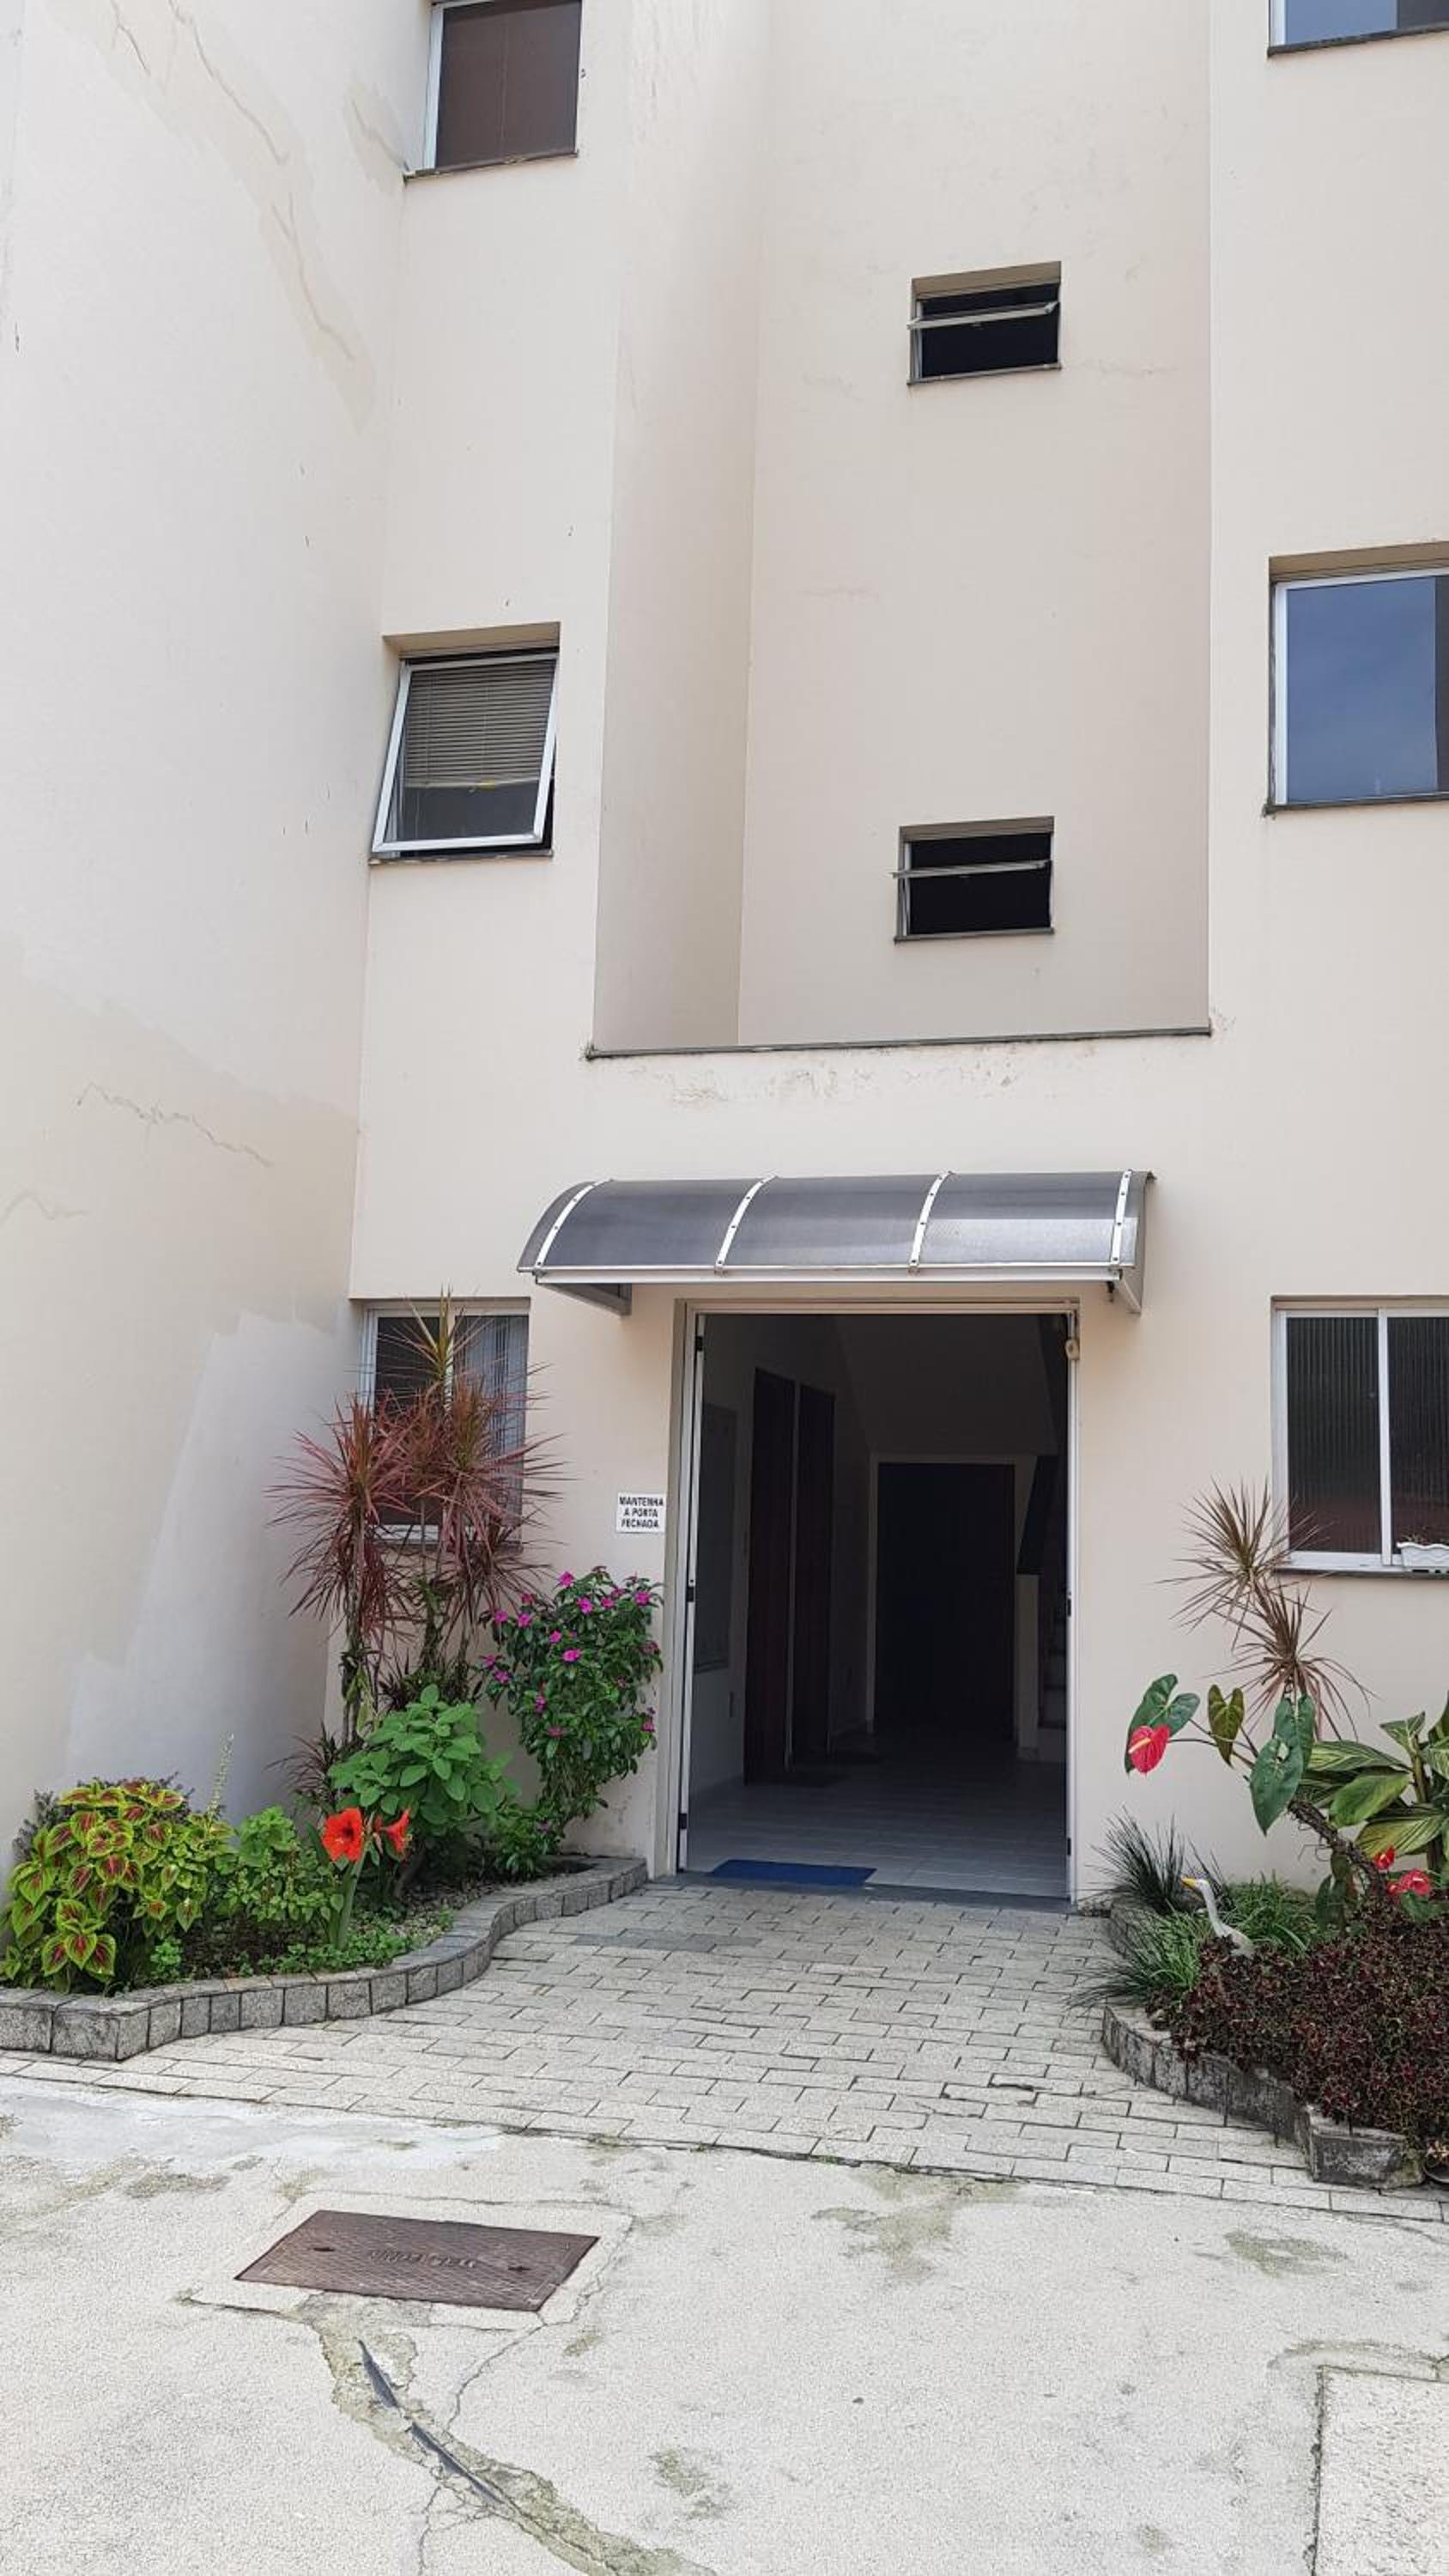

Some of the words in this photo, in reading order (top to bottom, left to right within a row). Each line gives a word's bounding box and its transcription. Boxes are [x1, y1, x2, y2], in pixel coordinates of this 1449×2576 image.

[619, 1497, 664, 1506] MANTENHA
[623, 1508, 630, 1516] A
[631, 1508, 658, 1517] PORTA
[621, 1519, 659, 1528] FECHADA
